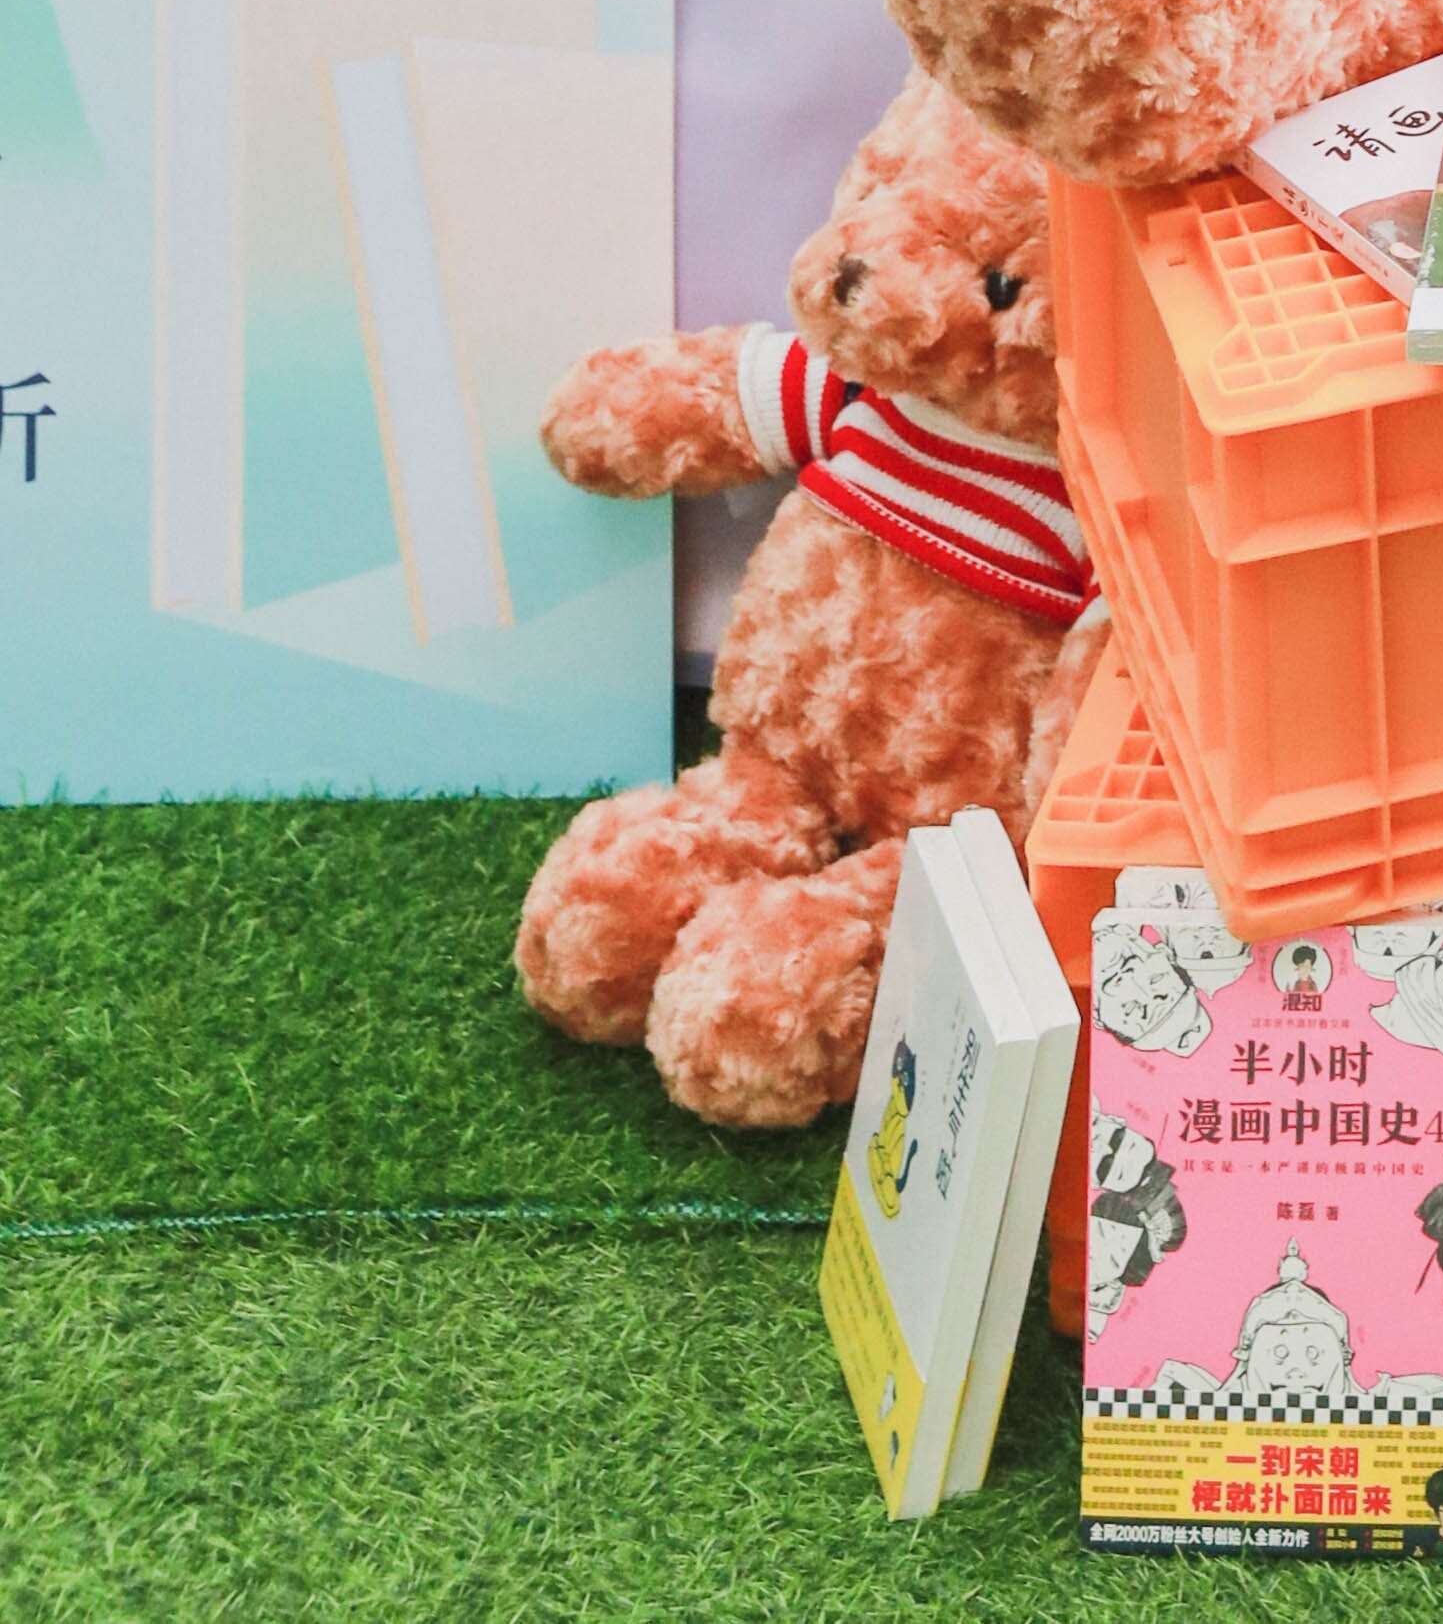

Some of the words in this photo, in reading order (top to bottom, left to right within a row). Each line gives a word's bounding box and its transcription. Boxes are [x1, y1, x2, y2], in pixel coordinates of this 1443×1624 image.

[1281, 993, 1323, 1012] 混知
[1230, 1040, 1373, 1087] 半小时
[1277, 1202, 1316, 1222] 陈磊
[1325, 1205, 1339, 1221] 著
[1226, 1445, 1360, 1478] 一到宋朝
[1192, 1480, 1393, 1517] 梗就扑面而来
